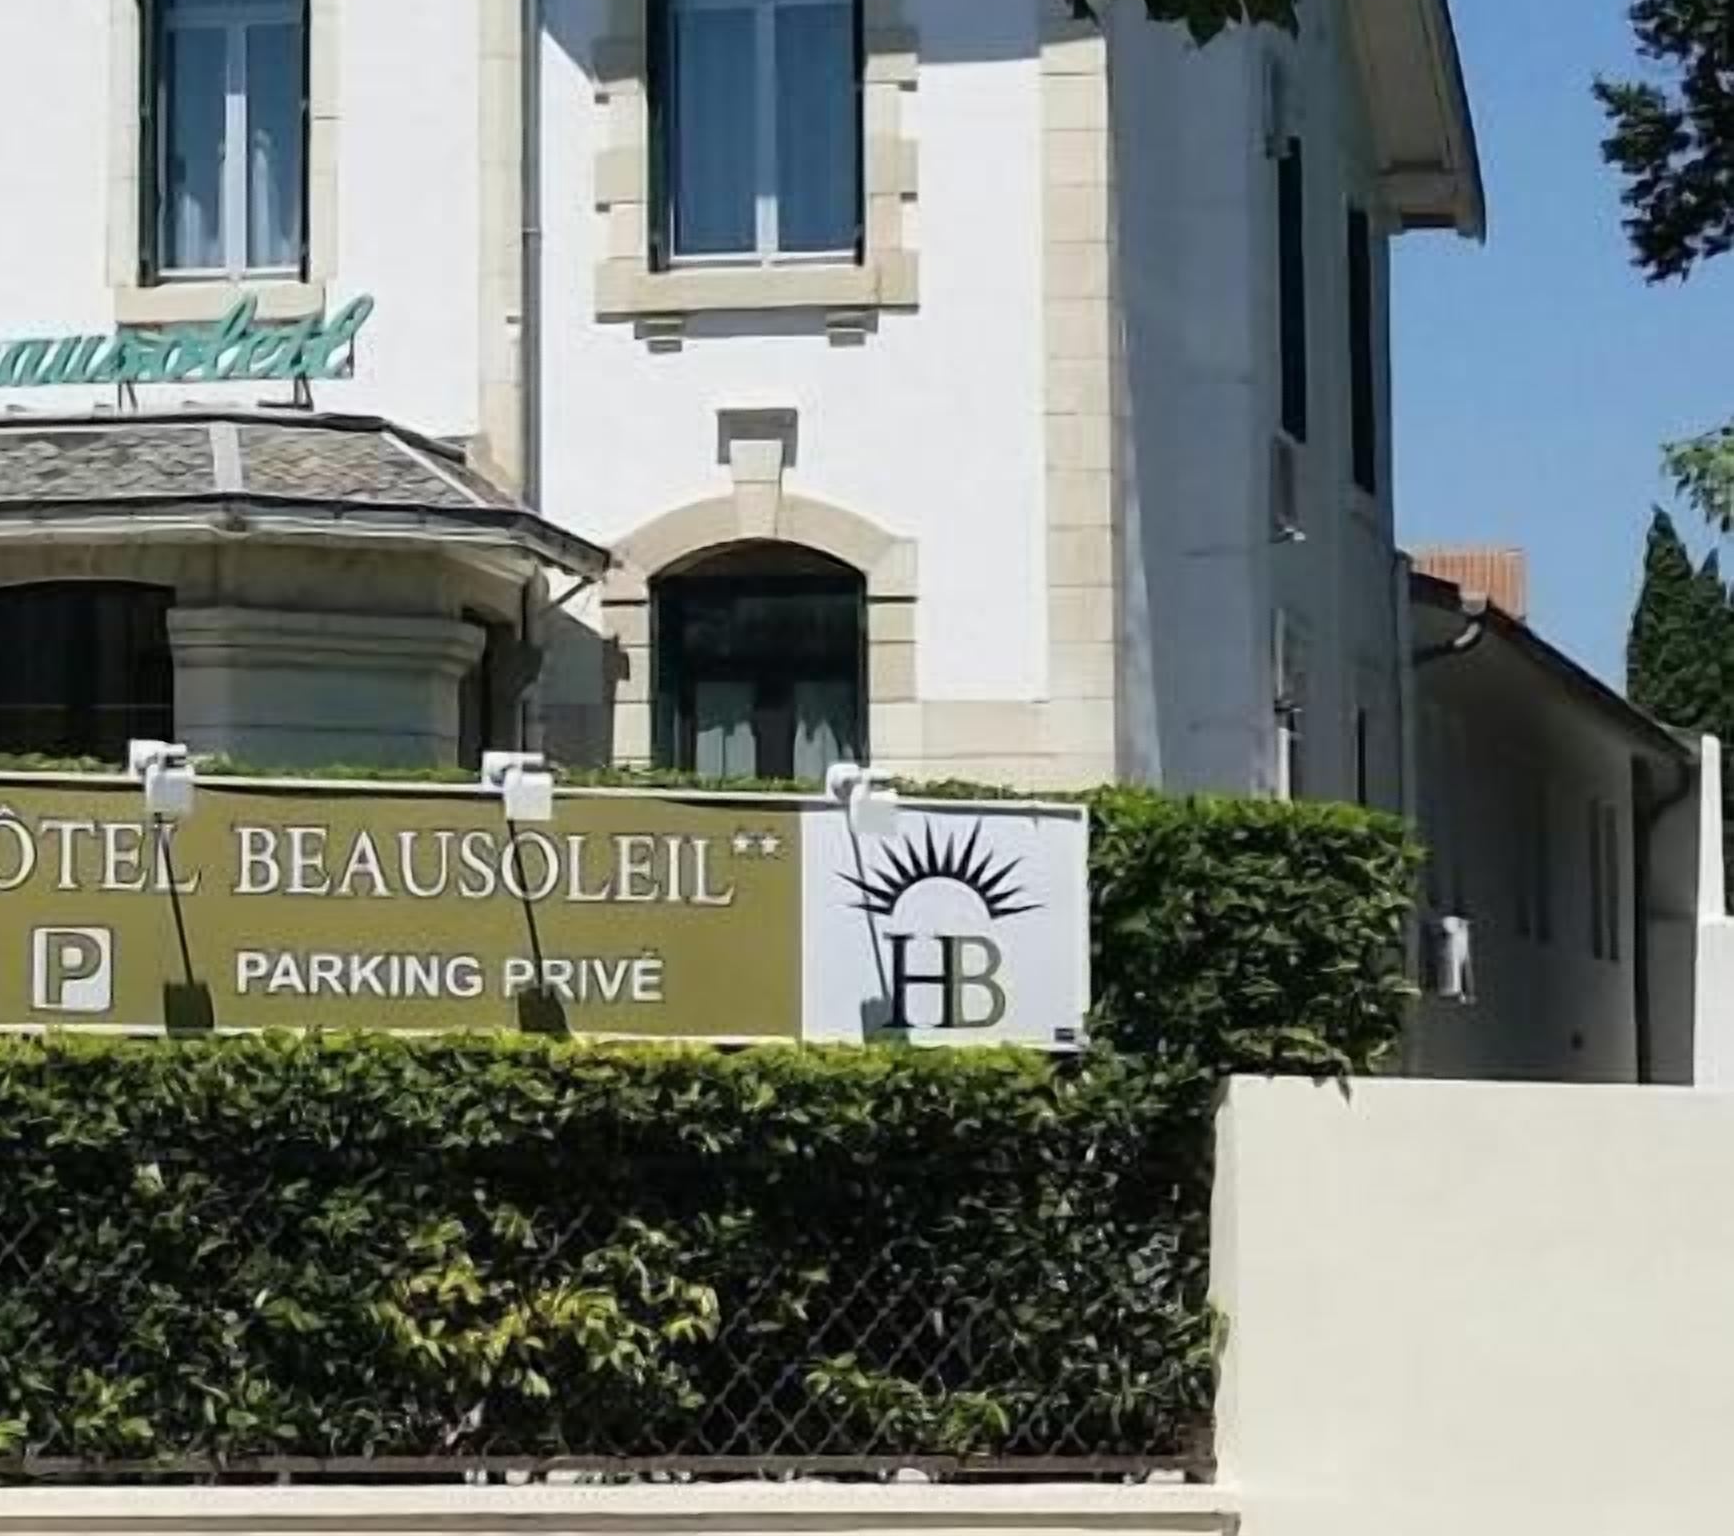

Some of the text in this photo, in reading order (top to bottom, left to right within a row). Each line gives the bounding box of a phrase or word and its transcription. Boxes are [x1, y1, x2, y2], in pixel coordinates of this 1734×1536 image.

[233, 826, 734, 906] BEAUSOLEIL
[46, 932, 102, 1005] P
[236, 951, 663, 1001] PARKING PRIVÉ
[882, 932, 1006, 1028] HB
